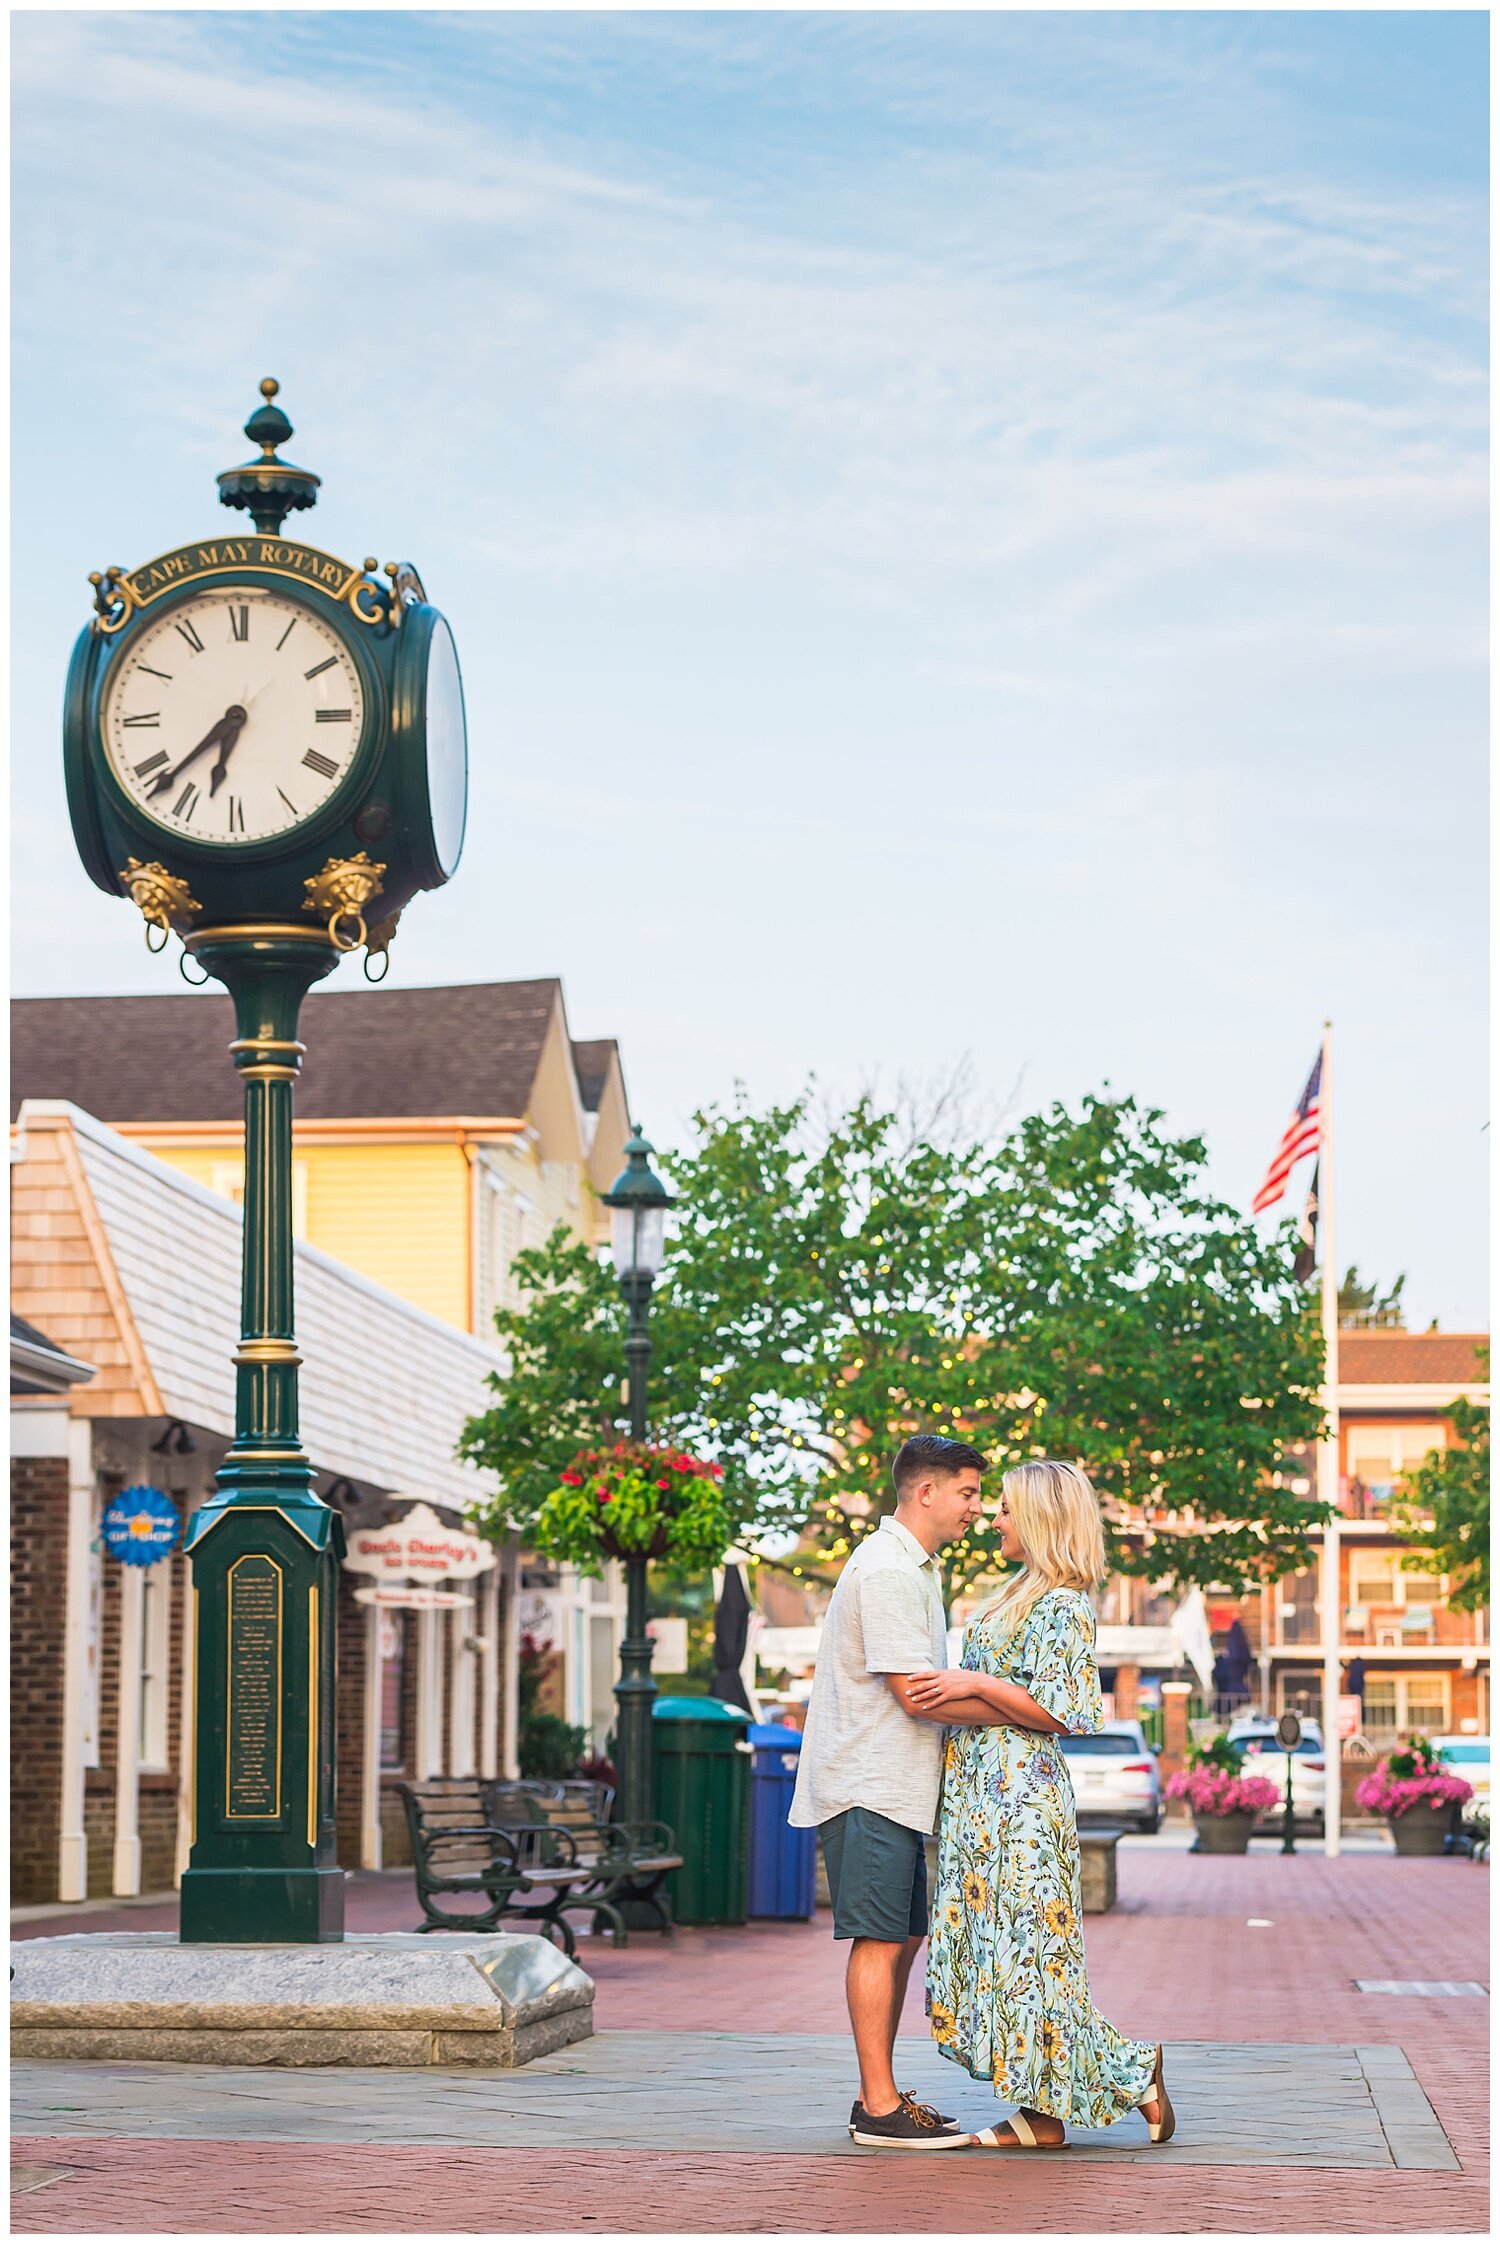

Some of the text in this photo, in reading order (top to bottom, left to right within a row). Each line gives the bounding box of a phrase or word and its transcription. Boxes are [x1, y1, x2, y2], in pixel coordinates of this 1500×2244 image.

[131, 543, 350, 595] CAPE MAY ROTARY
[227, 605, 249, 643] XII
[315, 708, 353, 724] III
